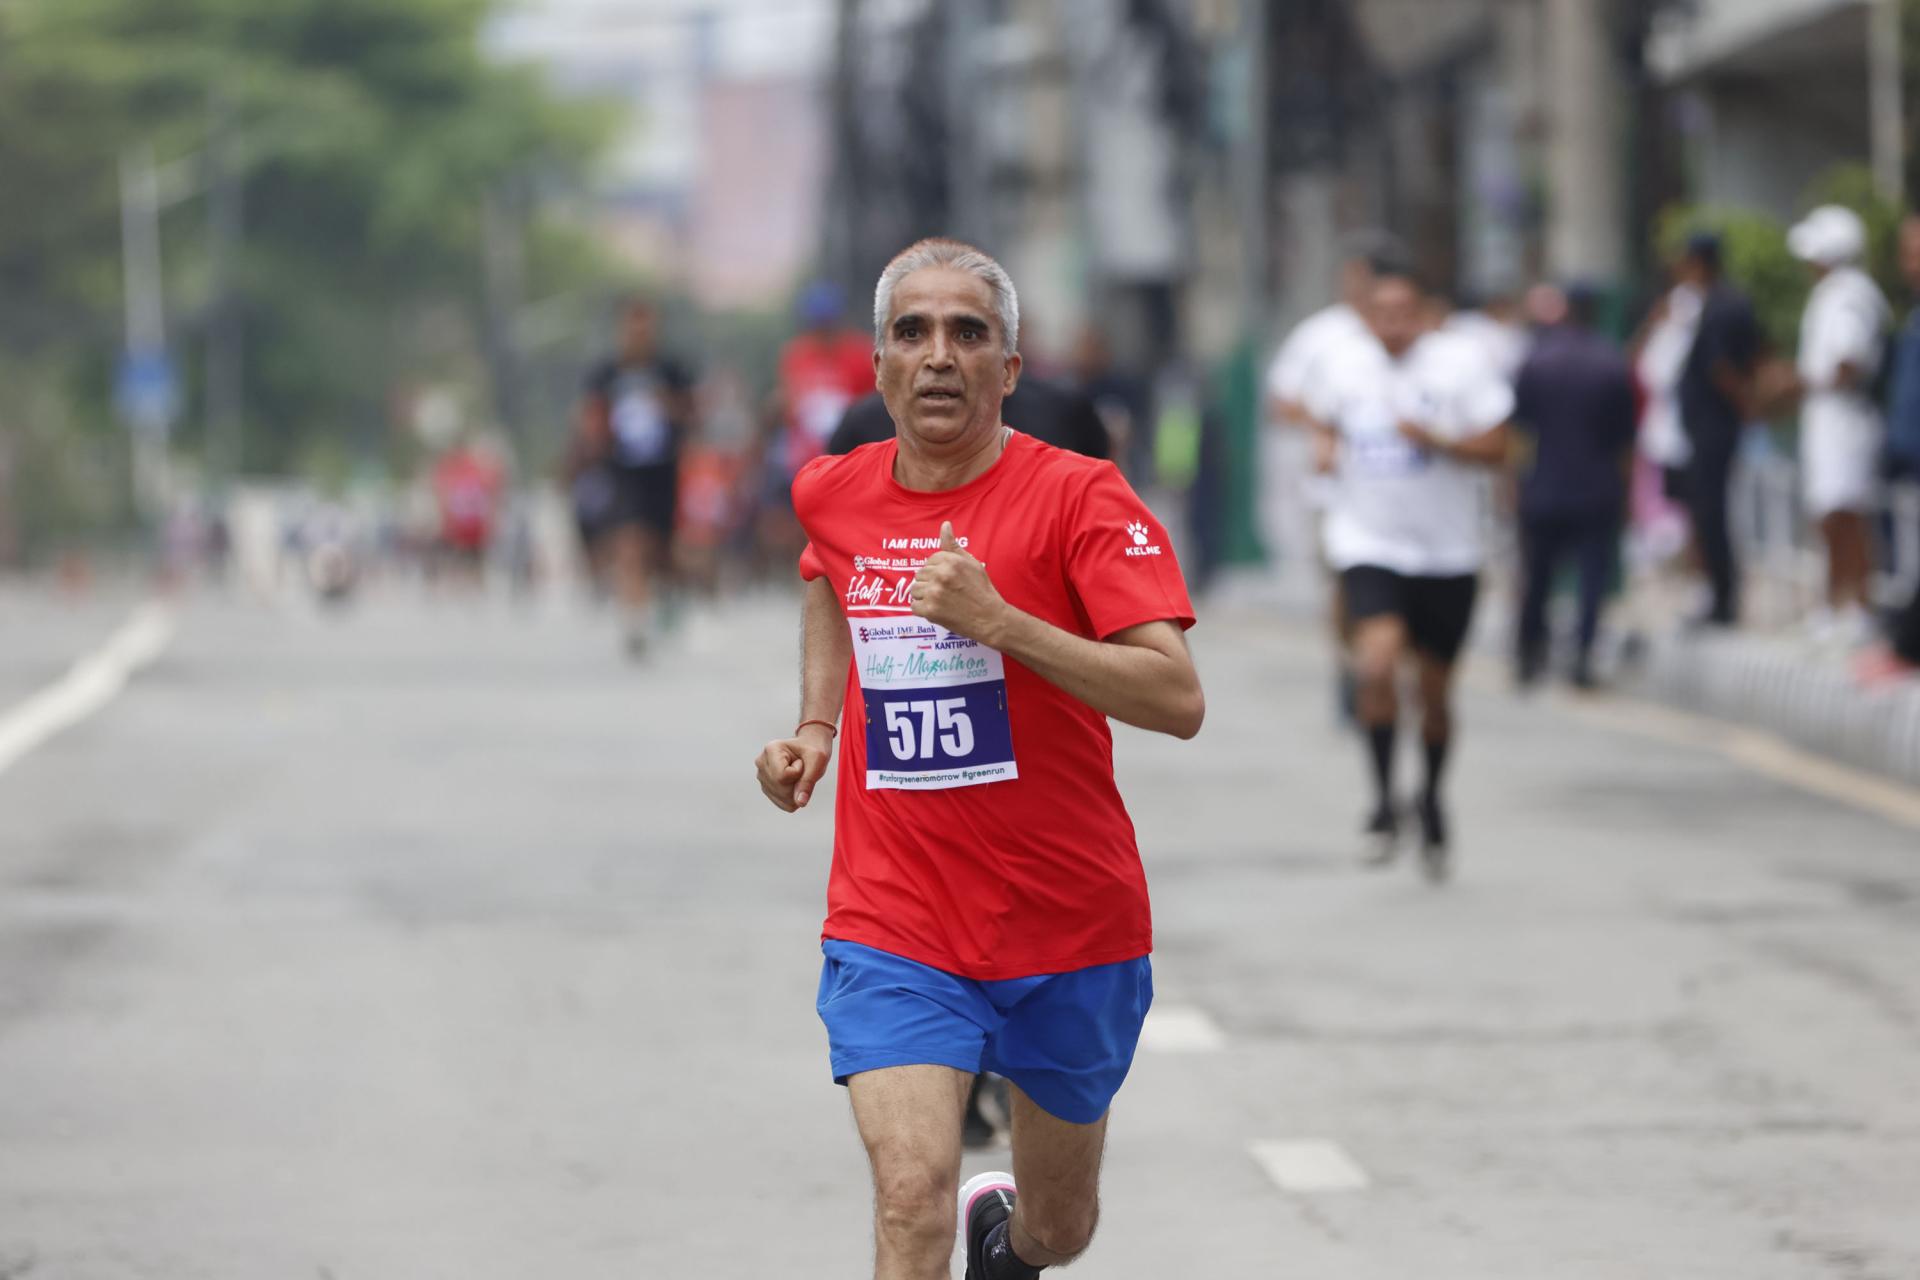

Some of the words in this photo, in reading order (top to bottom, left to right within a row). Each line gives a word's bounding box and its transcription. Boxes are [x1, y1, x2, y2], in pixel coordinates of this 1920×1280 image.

[887, 538, 908, 549] AM
[1125, 546, 1161, 556] KELNE
[864, 557, 889, 567] Global
[892, 558, 908, 567] IME
[869, 626, 894, 636] Global
[897, 626, 914, 634] IME
[917, 625, 936, 633] Bank
[934, 640, 978, 650] KANTIPUR
[966, 669, 988, 678] 2025
[884, 697, 975, 760] 575
[962, 768, 1005, 780] #greenrun
